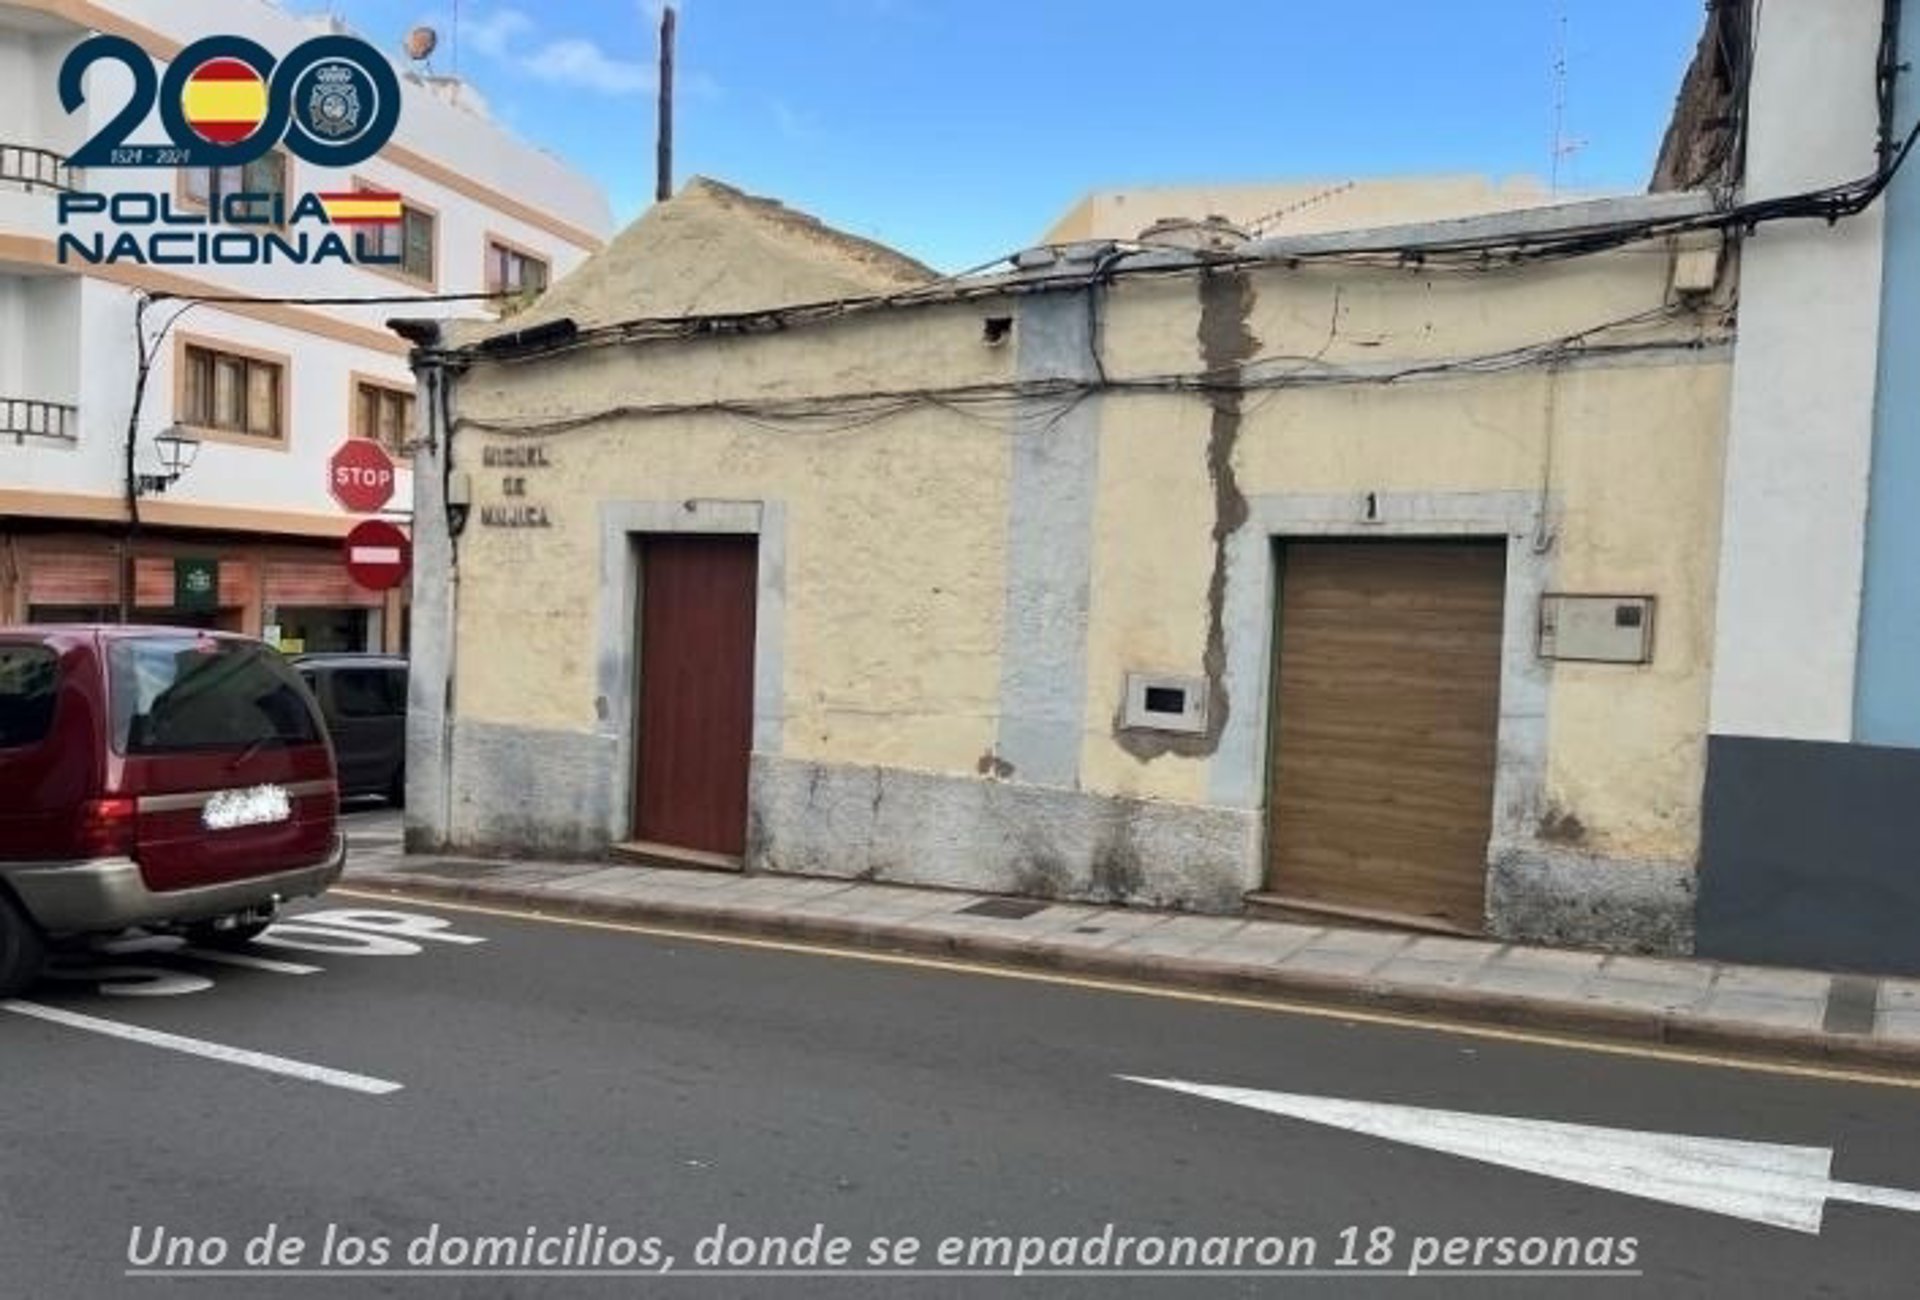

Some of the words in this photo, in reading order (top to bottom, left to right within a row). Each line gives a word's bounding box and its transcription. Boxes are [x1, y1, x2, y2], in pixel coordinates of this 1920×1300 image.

[482, 444, 552, 468] MIGUEL
[335, 466, 391, 487] STOP
[501, 476, 527, 497] DE
[480, 505, 553, 528] MUJICA
[1366, 490, 1377, 520] 1
